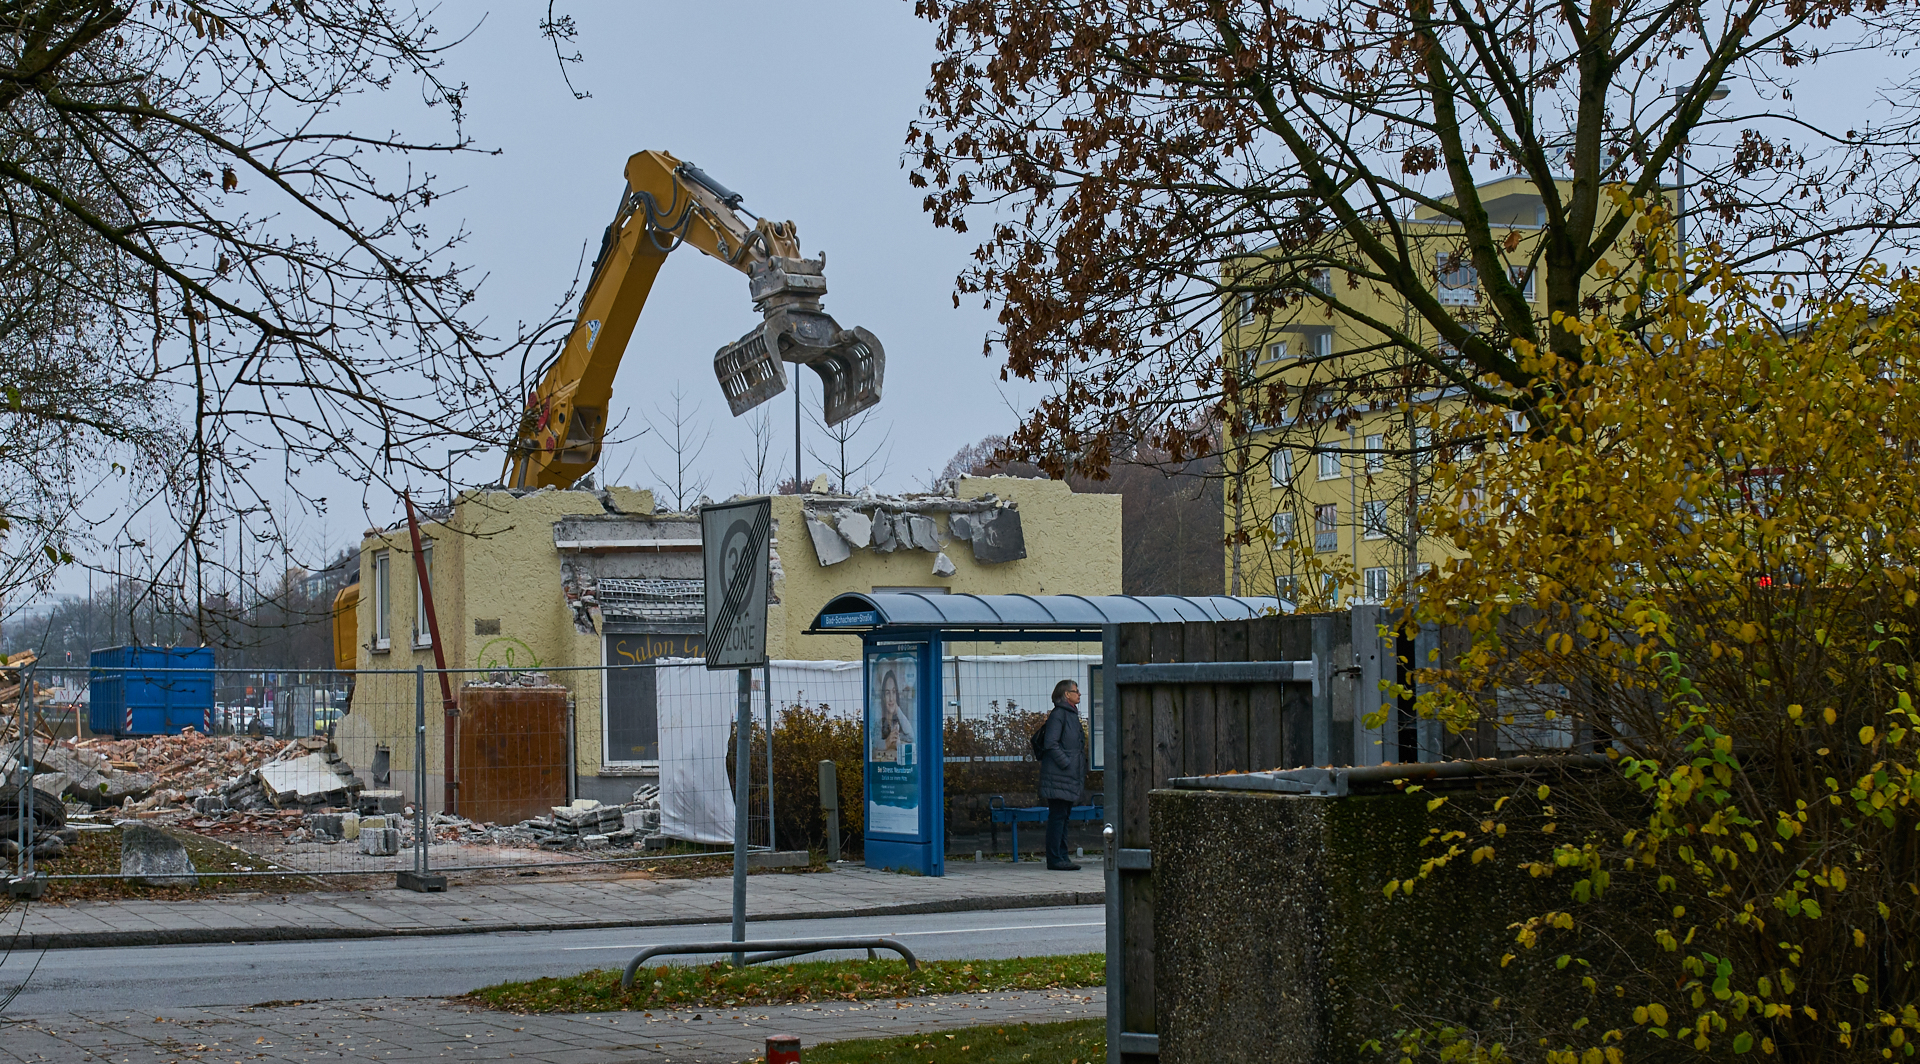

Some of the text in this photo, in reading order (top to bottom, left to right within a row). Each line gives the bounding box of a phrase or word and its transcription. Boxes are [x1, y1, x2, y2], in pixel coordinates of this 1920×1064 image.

[825, 613, 873, 625] Bad-Schachener-Straße
[616, 633, 677, 671] Salon
[725, 624, 756, 652] ZONE
